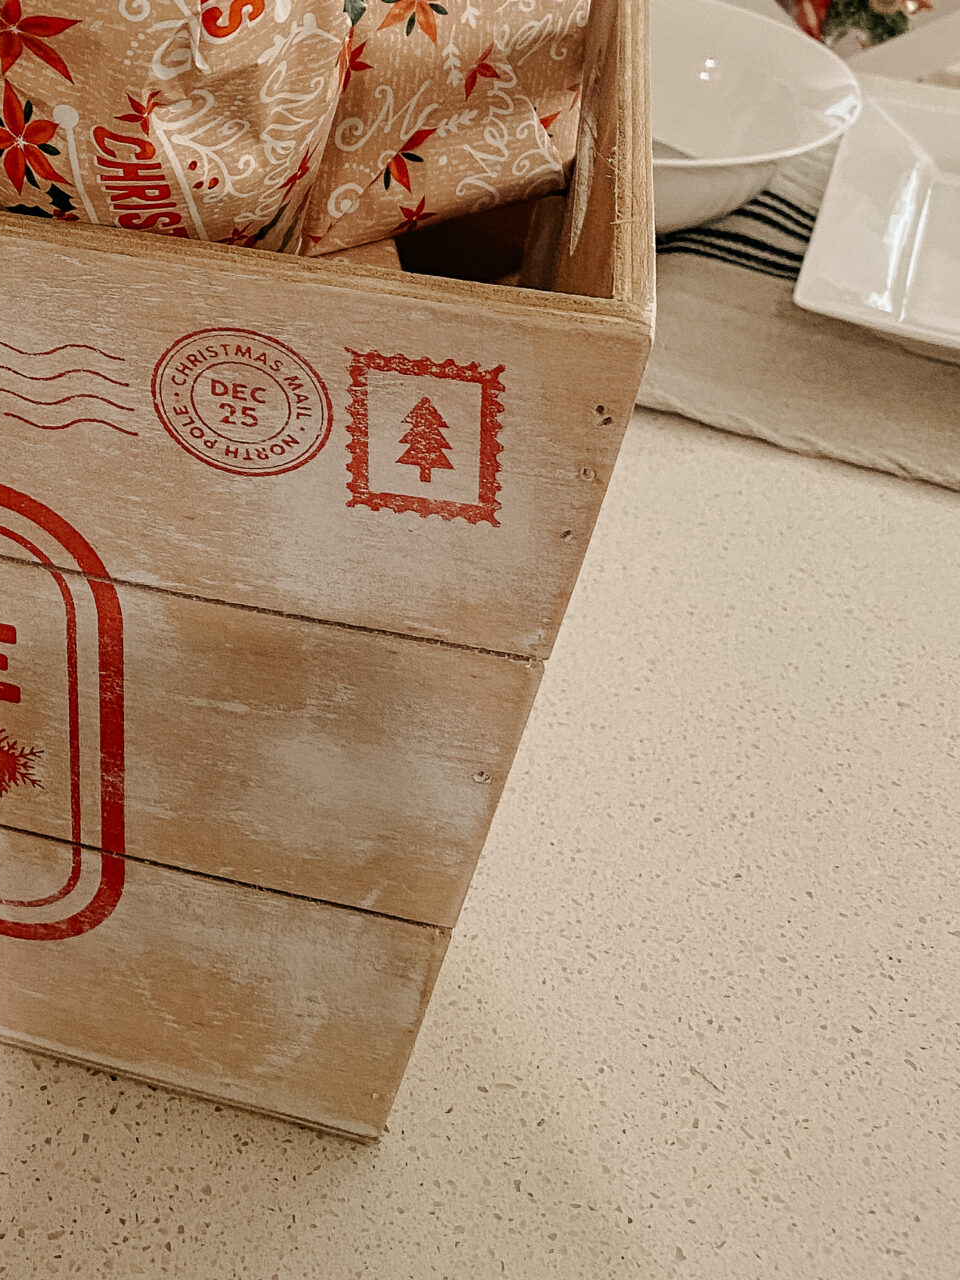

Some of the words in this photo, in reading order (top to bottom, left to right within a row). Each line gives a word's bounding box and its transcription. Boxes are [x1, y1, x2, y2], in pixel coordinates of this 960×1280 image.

[171, 343, 284, 386] CHRISTMAS
[283, 375, 312, 420] MAIL
[210, 378, 266, 404] DEC
[173, 405, 218, 449] POLE
[218, 402, 259, 428] 25
[224, 434, 300, 461] NORTH
